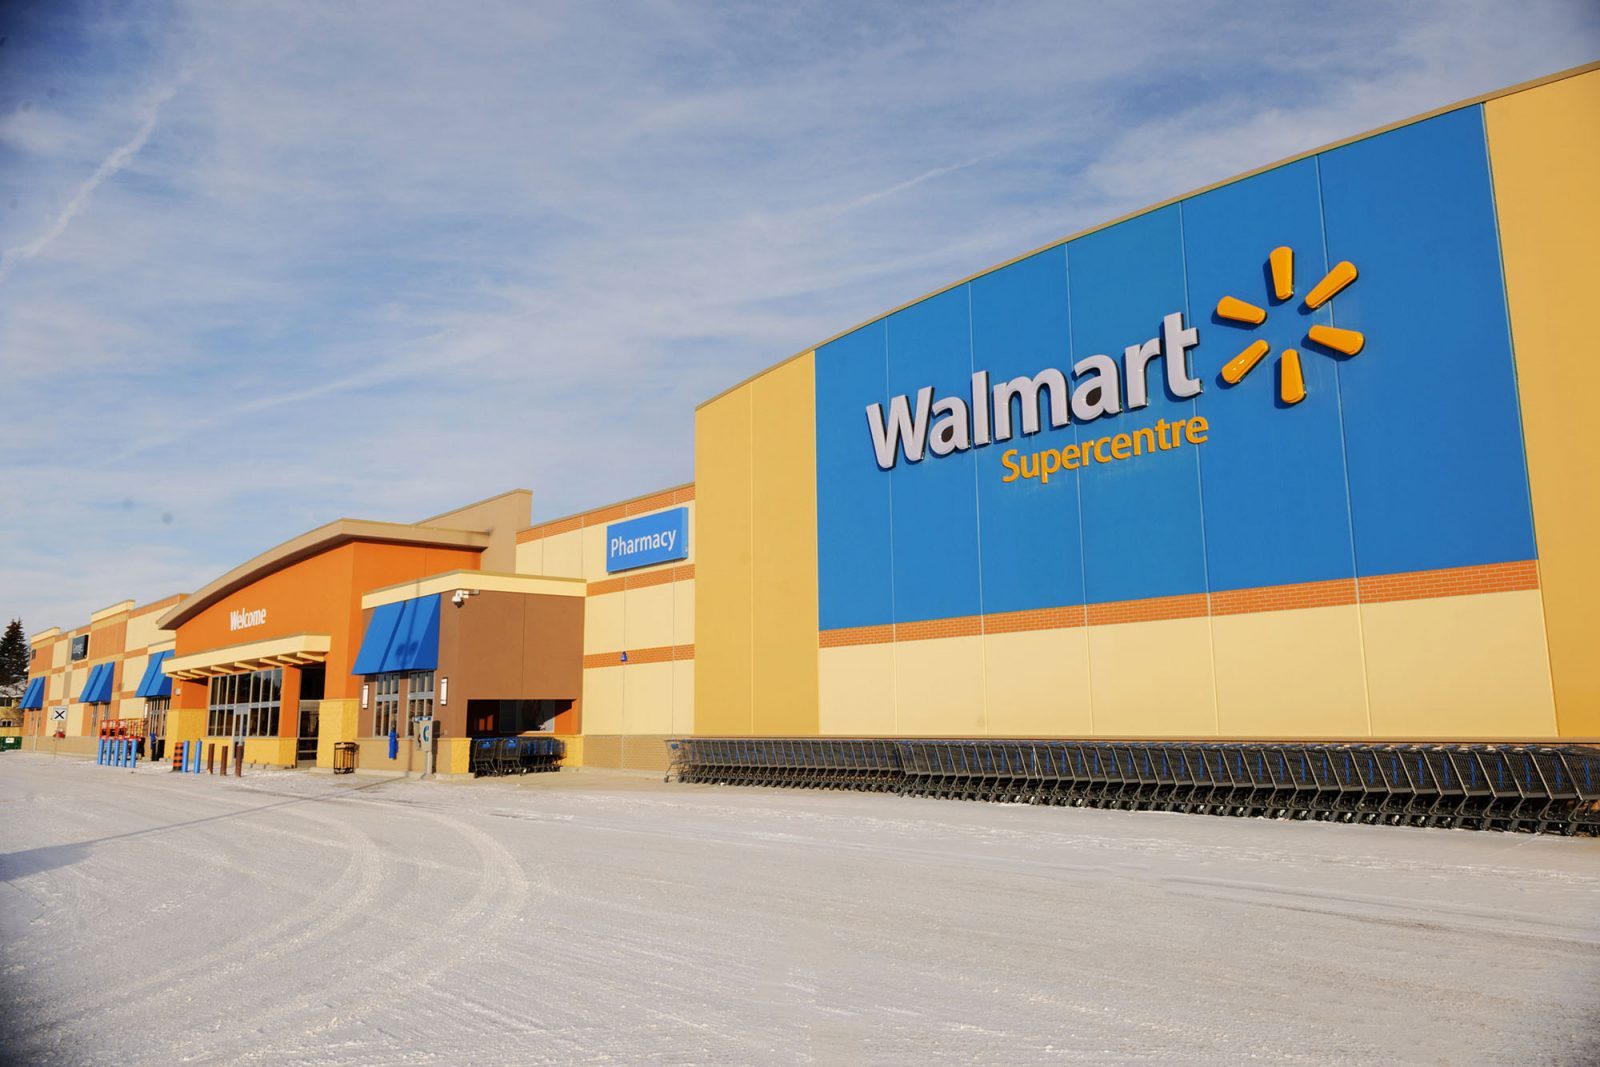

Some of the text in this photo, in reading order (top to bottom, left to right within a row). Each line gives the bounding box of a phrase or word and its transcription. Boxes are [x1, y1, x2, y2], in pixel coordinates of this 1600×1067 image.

[865, 312, 1204, 469] Walmart
[1001, 415, 1209, 484] Supercentre
[611, 529, 676, 558] Pharmacy
[230, 607, 267, 632] Welcome
